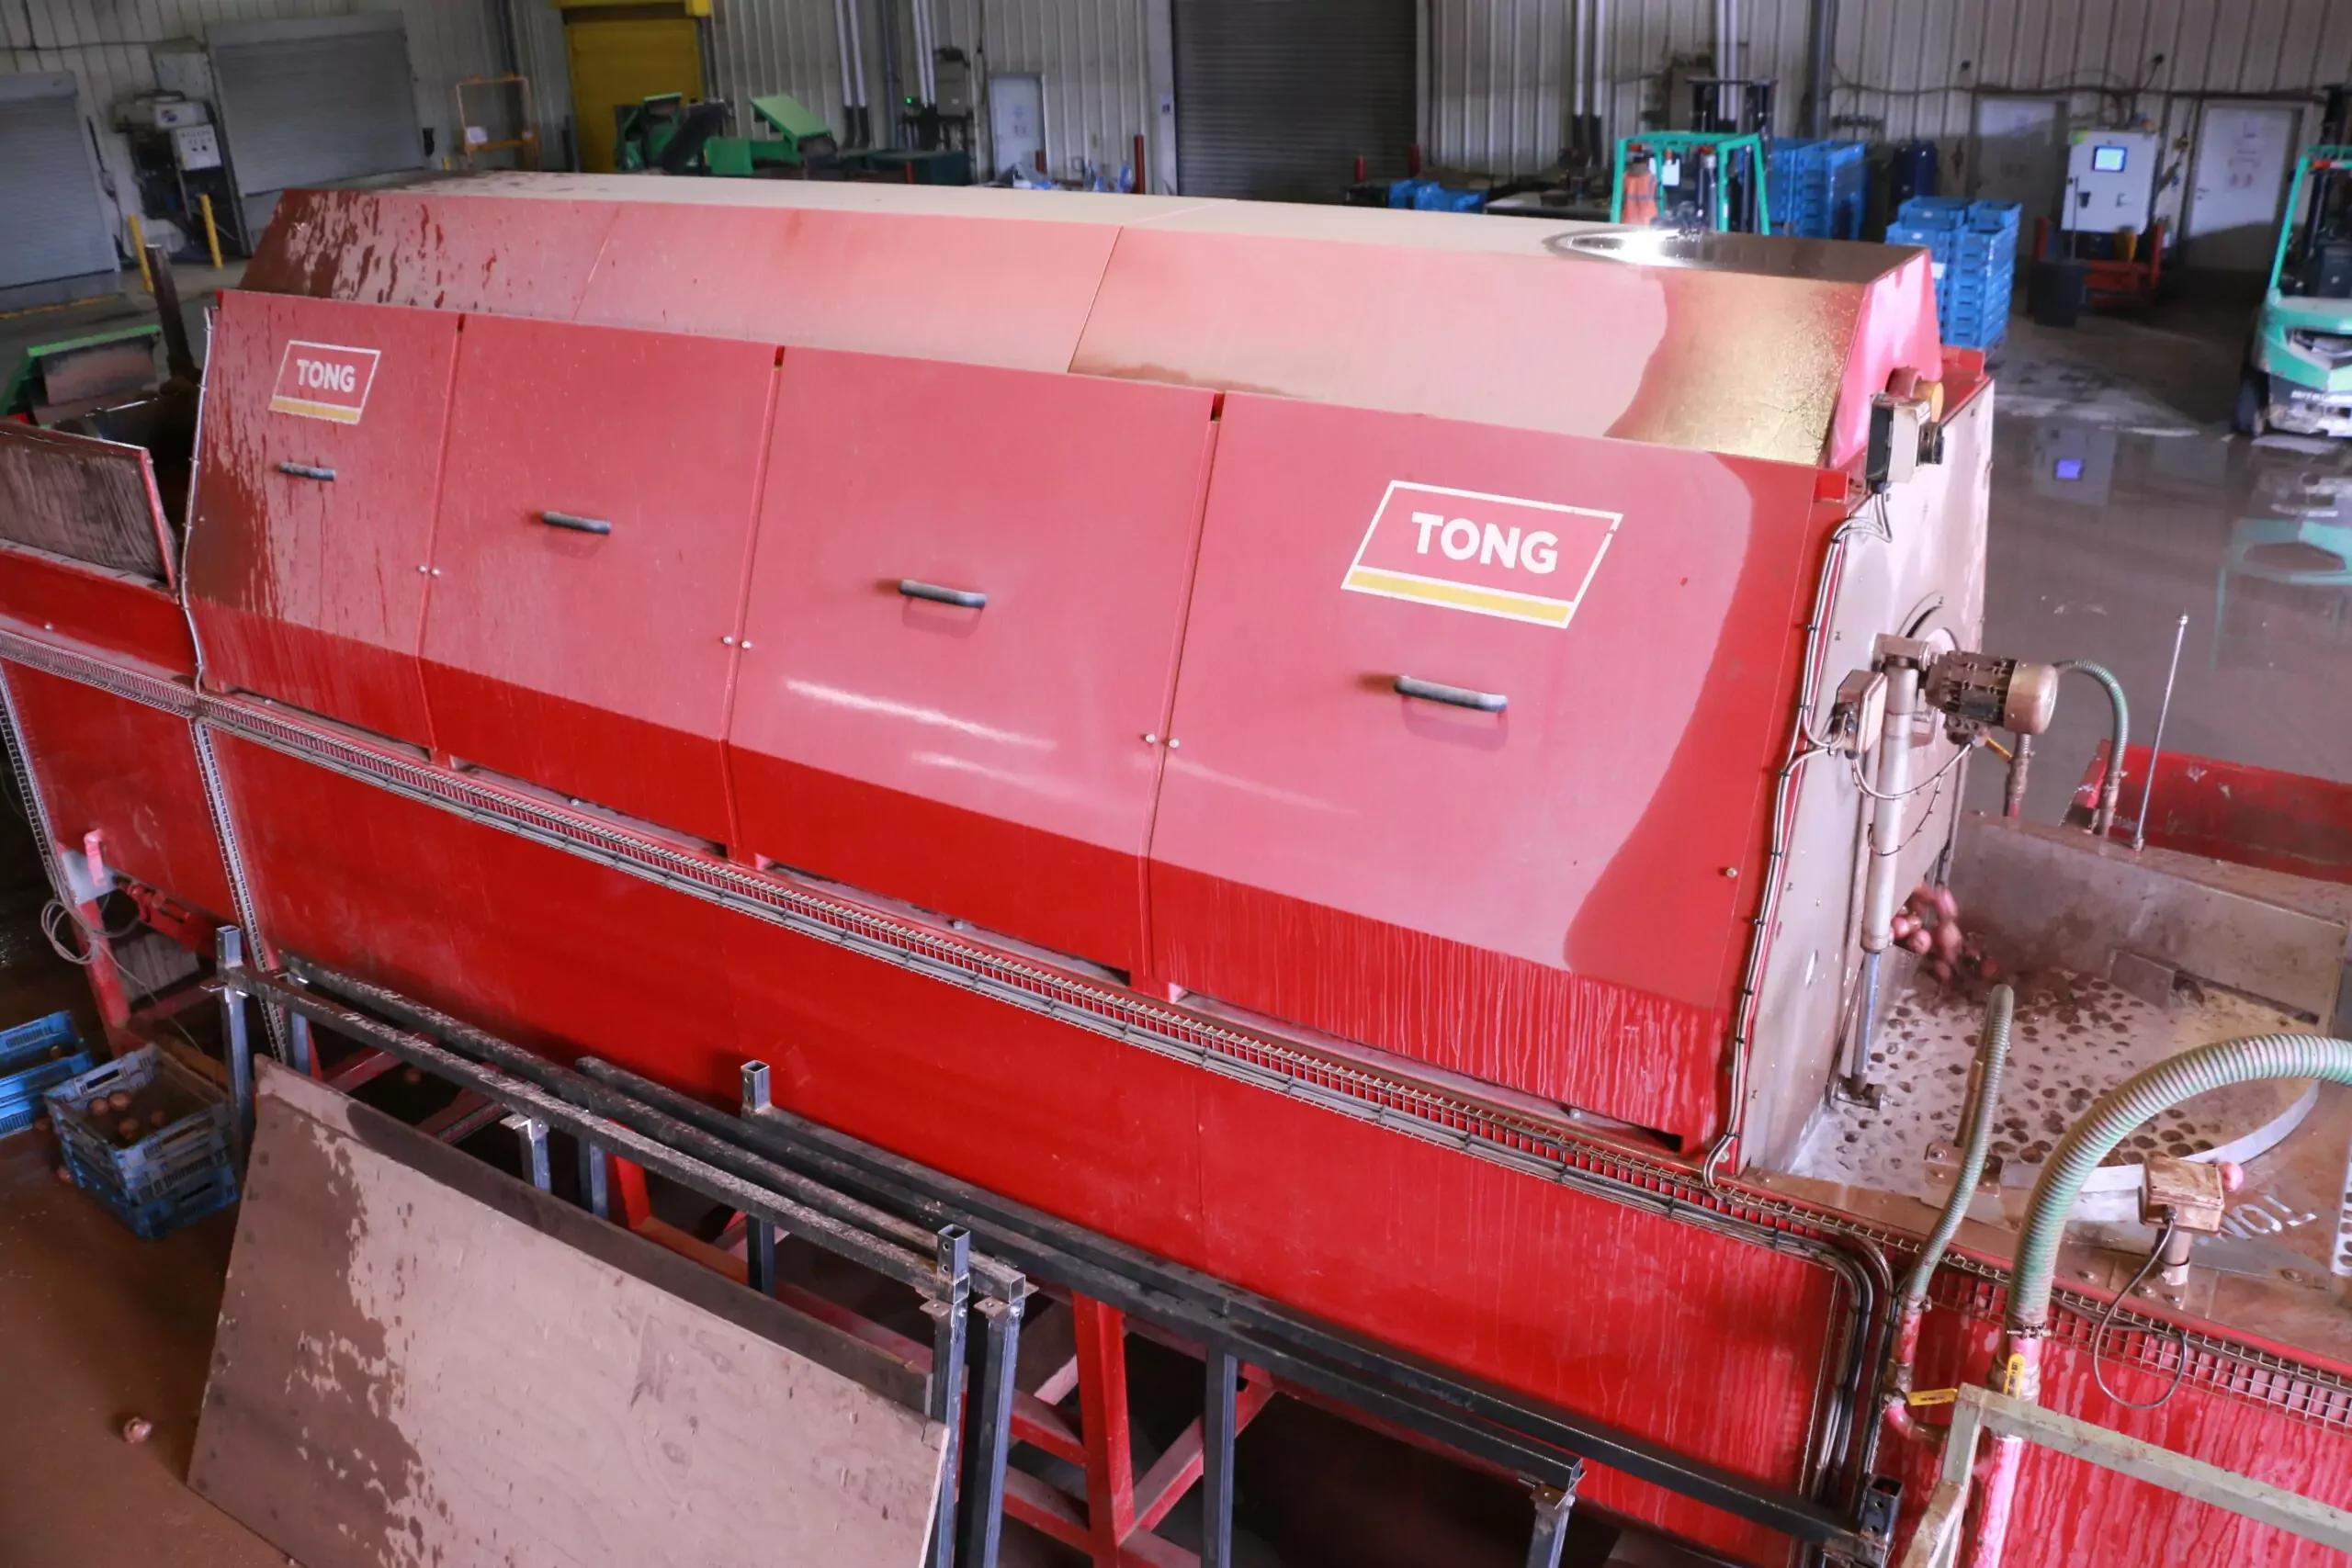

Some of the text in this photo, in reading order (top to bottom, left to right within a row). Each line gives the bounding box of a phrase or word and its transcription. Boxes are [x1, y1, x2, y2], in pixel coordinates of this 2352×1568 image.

[297, 359, 356, 392] TONG
[1411, 511, 1559, 574] TONG
[2218, 1193, 2318, 1242] TO
